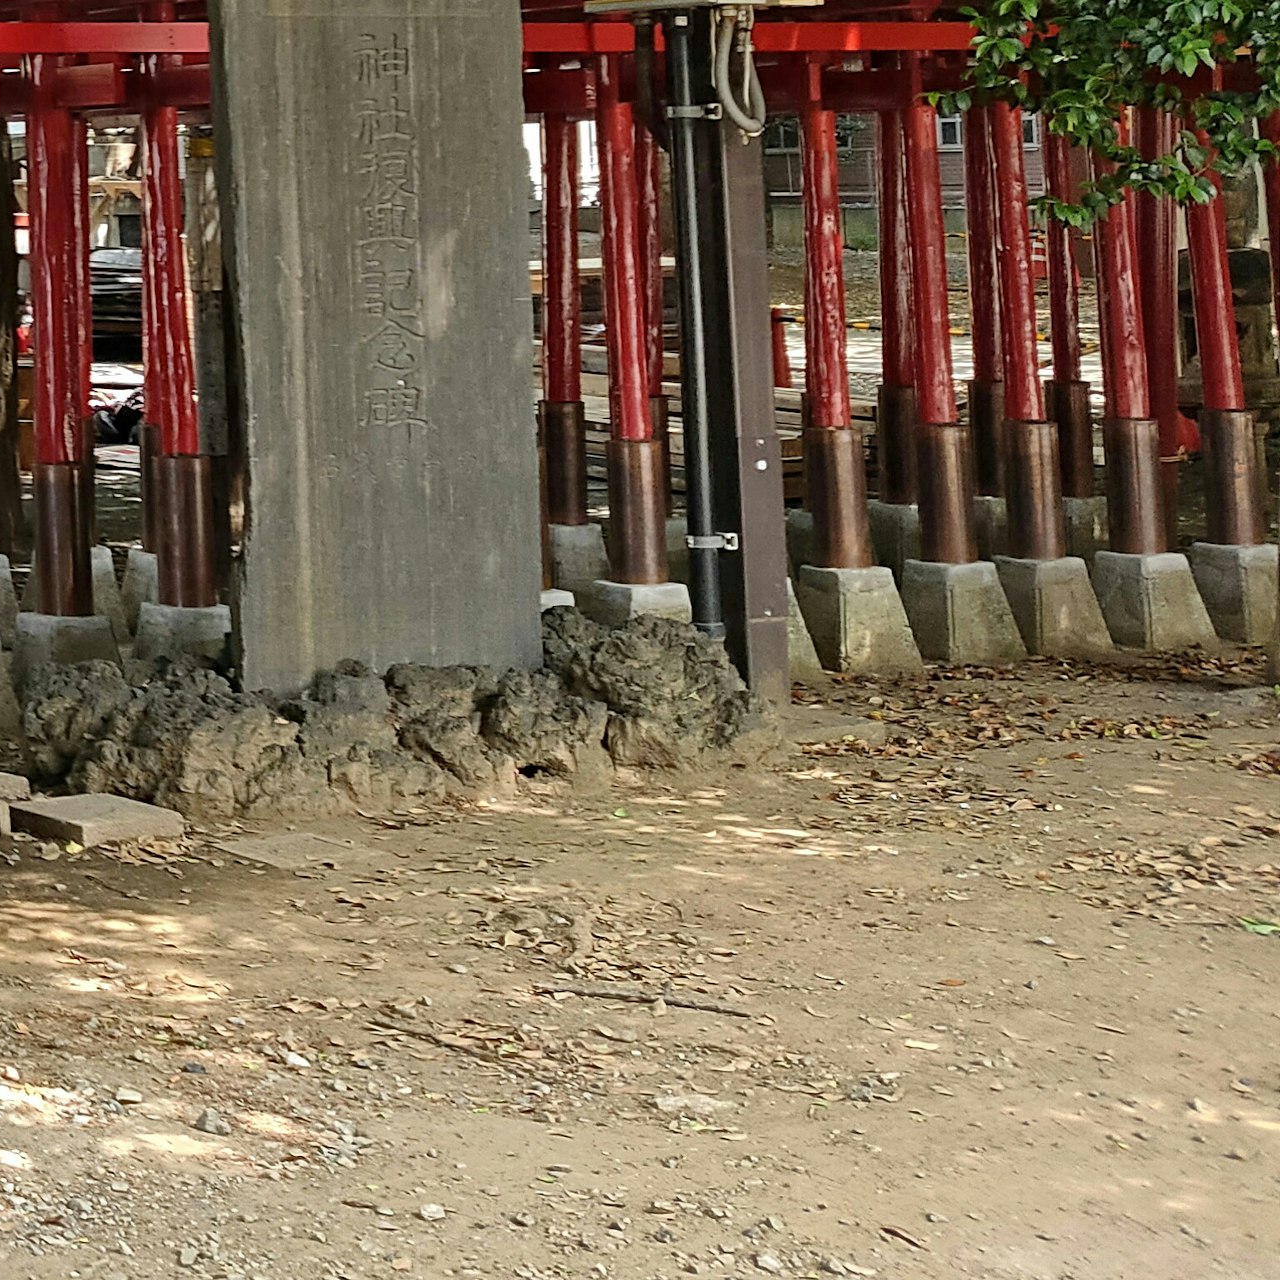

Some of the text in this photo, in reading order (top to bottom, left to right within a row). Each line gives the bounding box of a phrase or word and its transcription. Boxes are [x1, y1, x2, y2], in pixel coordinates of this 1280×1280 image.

[351, 31, 429, 444] 神社復興記念碑
